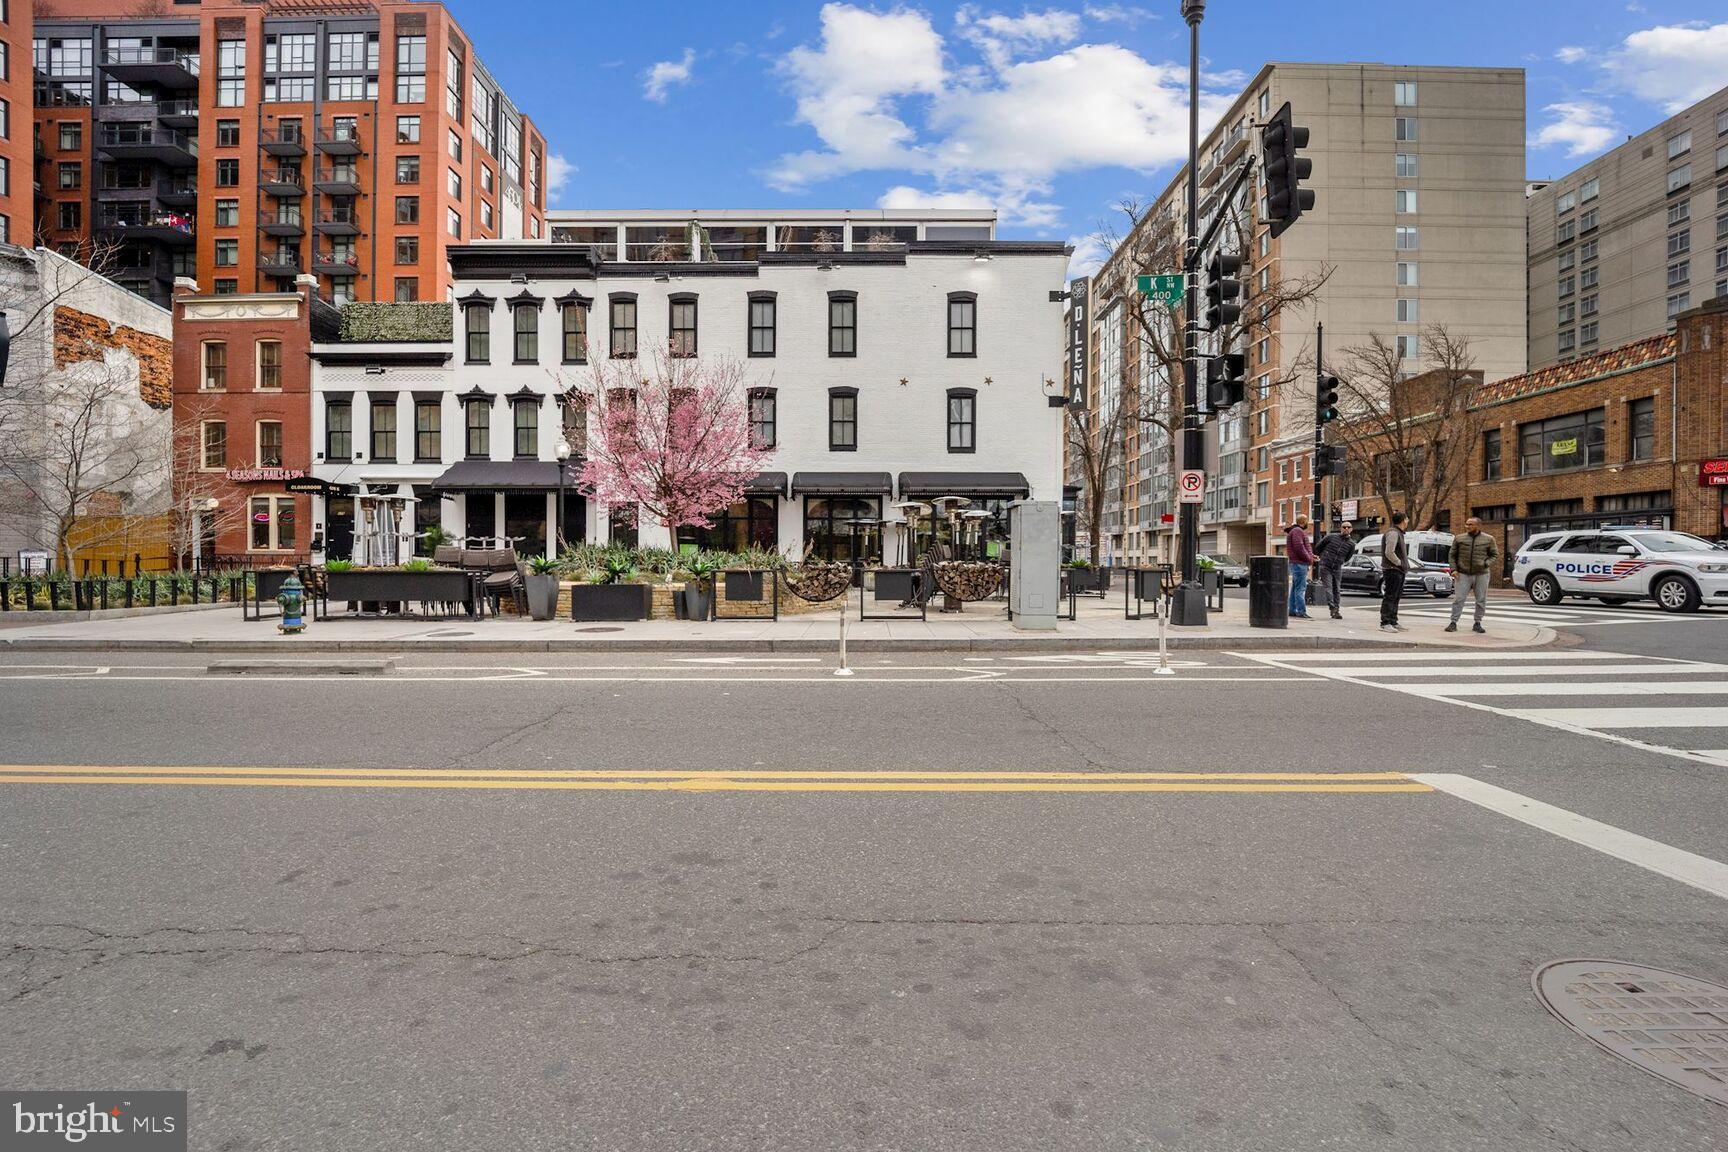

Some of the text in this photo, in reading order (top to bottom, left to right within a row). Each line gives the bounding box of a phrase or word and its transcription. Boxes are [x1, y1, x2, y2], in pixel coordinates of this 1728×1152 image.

[1150, 278, 1157, 290] K
[1152, 291, 1171, 300] 400
[263, 470, 284, 480] NAILS
[1555, 563, 1612, 575] POLICE
